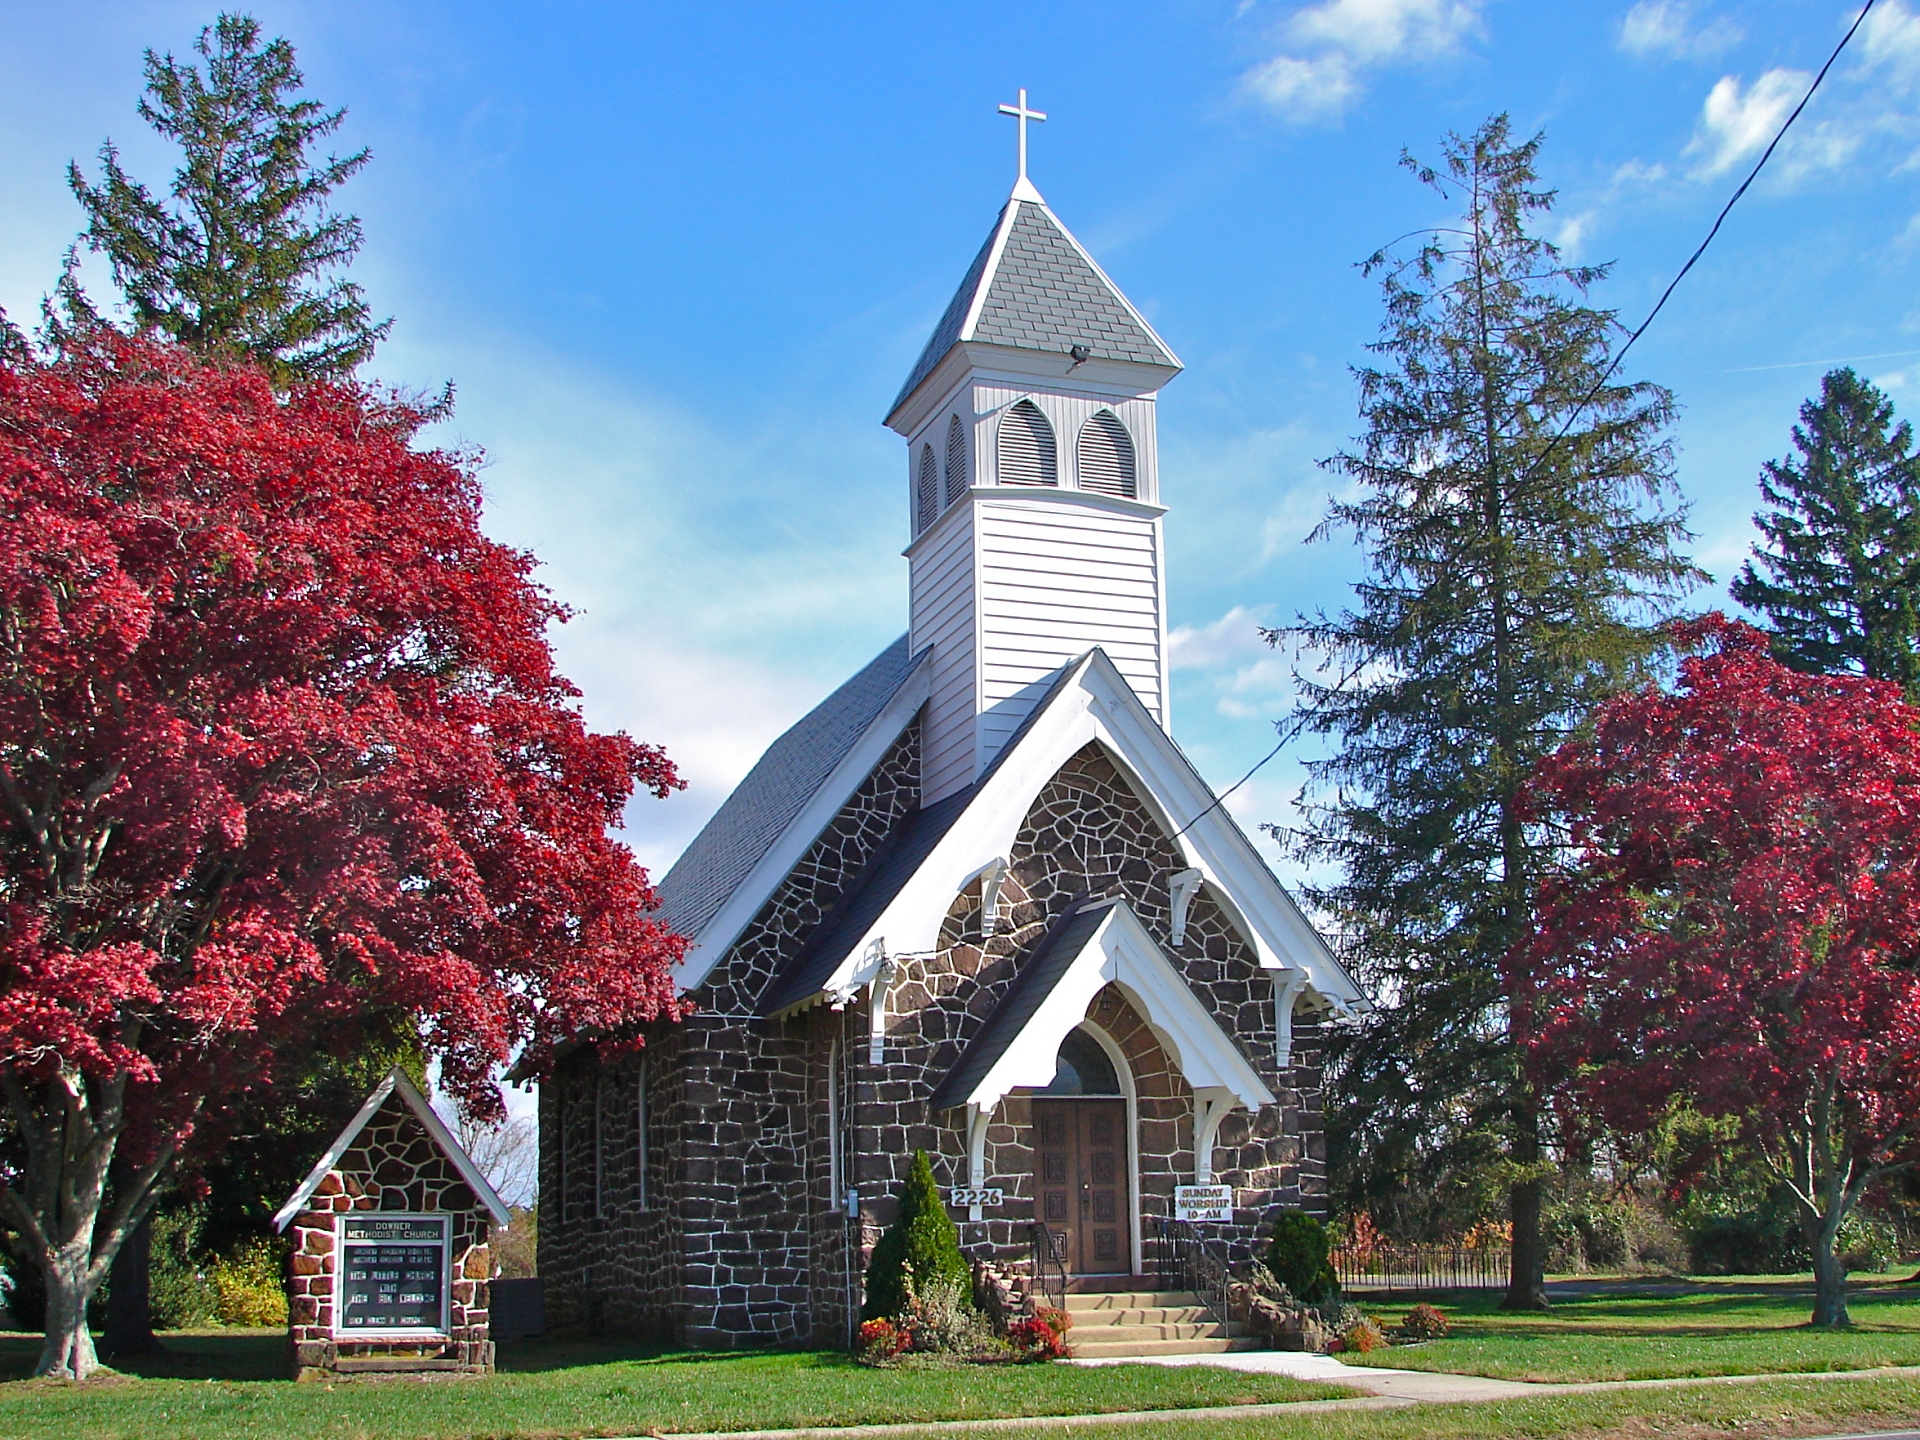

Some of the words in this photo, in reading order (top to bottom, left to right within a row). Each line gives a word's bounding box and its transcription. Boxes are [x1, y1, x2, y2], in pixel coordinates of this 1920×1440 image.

[954, 1190, 1000, 1205] 2226
[1182, 1188, 1223, 1198] SUNDAY
[1179, 1199, 1230, 1209] WORSHIP
[375, 1222, 411, 1230] DOWNER
[347, 1230, 396, 1238] METHODIST
[403, 1230, 438, 1238] CHURCH
